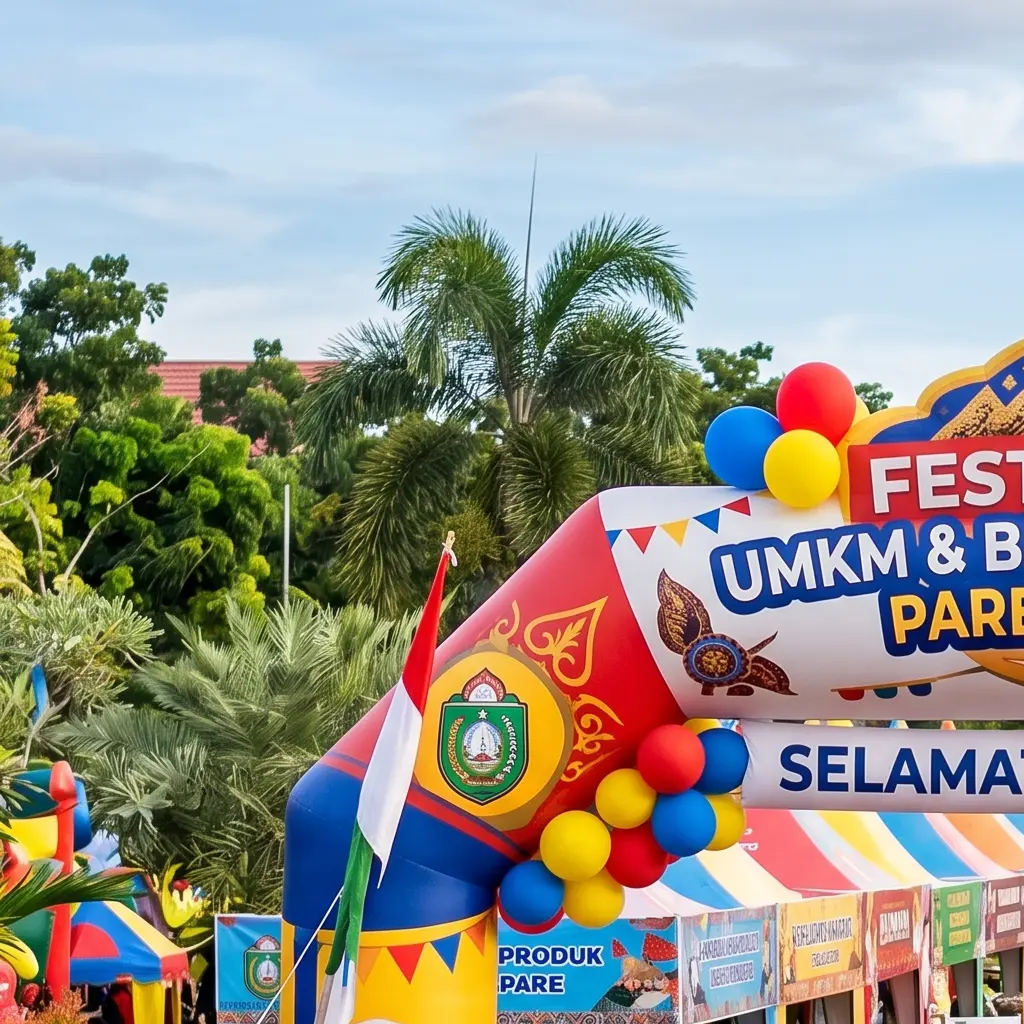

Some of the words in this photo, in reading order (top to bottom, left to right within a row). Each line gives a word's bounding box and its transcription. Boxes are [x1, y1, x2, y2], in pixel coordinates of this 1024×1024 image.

[720, 527, 909, 603] UMKM
[929, 524, 966, 575] &
[498, 946, 603, 965] PRODUK
[498, 974, 565, 993] PARE
